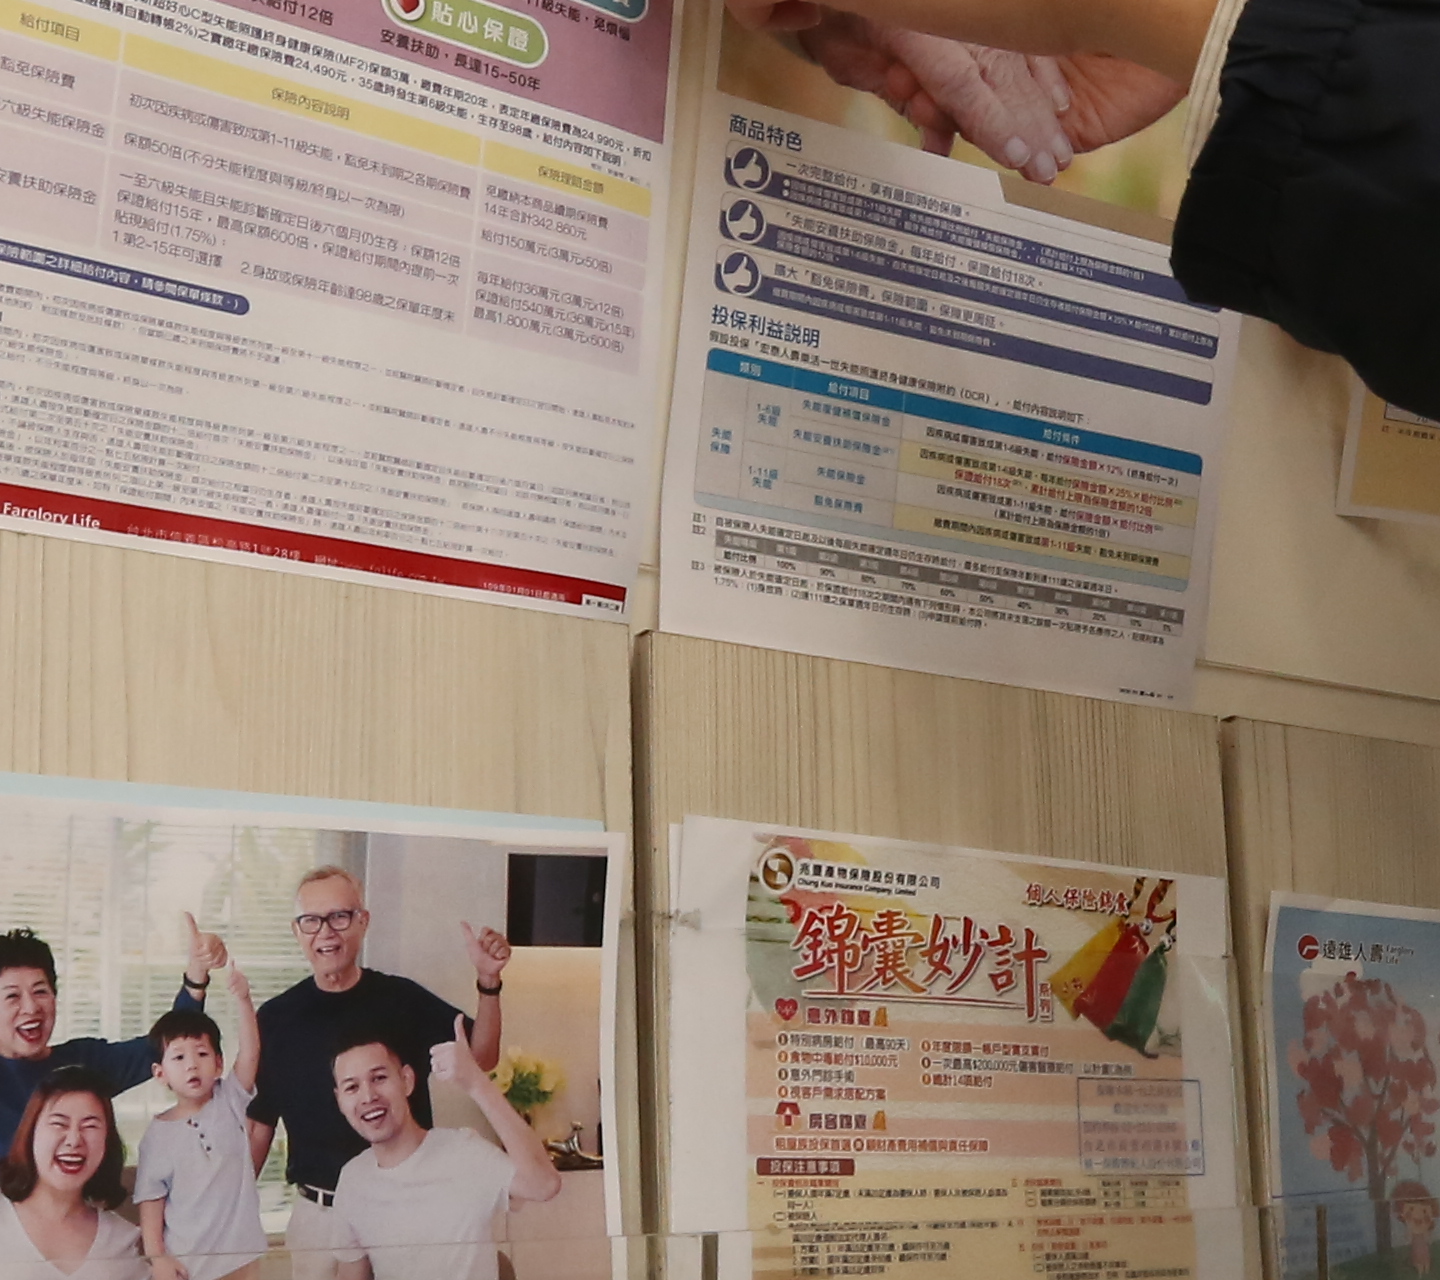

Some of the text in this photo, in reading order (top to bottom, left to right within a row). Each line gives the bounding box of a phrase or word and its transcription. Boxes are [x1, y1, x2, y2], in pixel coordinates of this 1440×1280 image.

[19, 12, 81, 42] 給付項目
[430, 0, 530, 53] 貼心保證
[728, 112, 804, 153] 商品特色
[71, 512, 101, 530] Life
[790, 901, 1049, 1020] 錦囊妙計
[1322, 939, 1385, 964] 遠雄人壽
